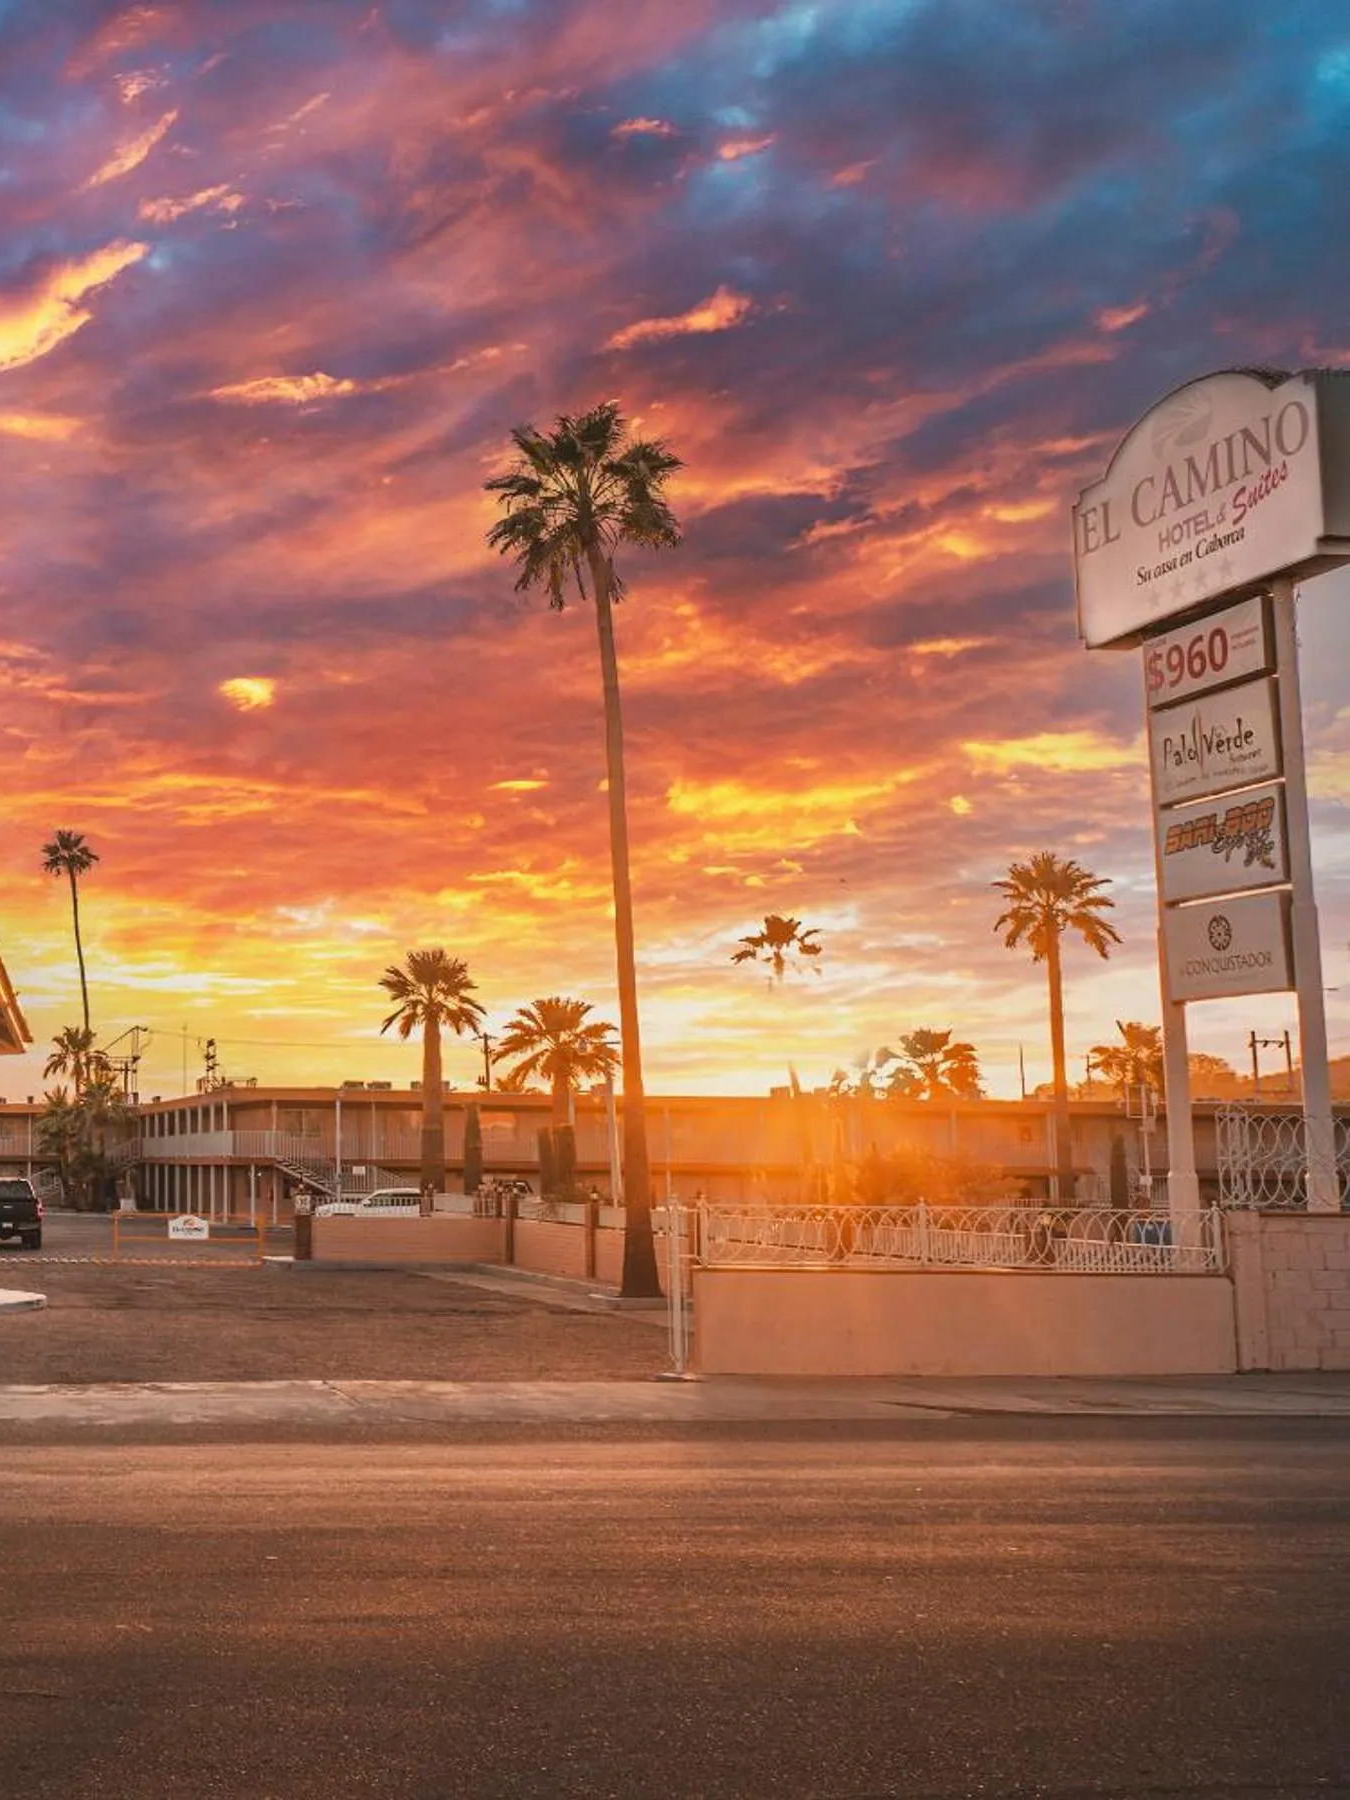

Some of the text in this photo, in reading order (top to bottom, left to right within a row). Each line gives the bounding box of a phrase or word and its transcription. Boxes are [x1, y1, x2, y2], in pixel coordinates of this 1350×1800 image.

[1079, 400, 1310, 556] EL CAMINO
[1158, 509, 1216, 553] HOTEL
[1232, 459, 1289, 527] Suites
[1136, 526, 1246, 587] Su casa en Caborca
[1147, 626, 1229, 696] $960
[1202, 717, 1254, 754] Verde
[1186, 951, 1274, 977] CONQUISTADOR
